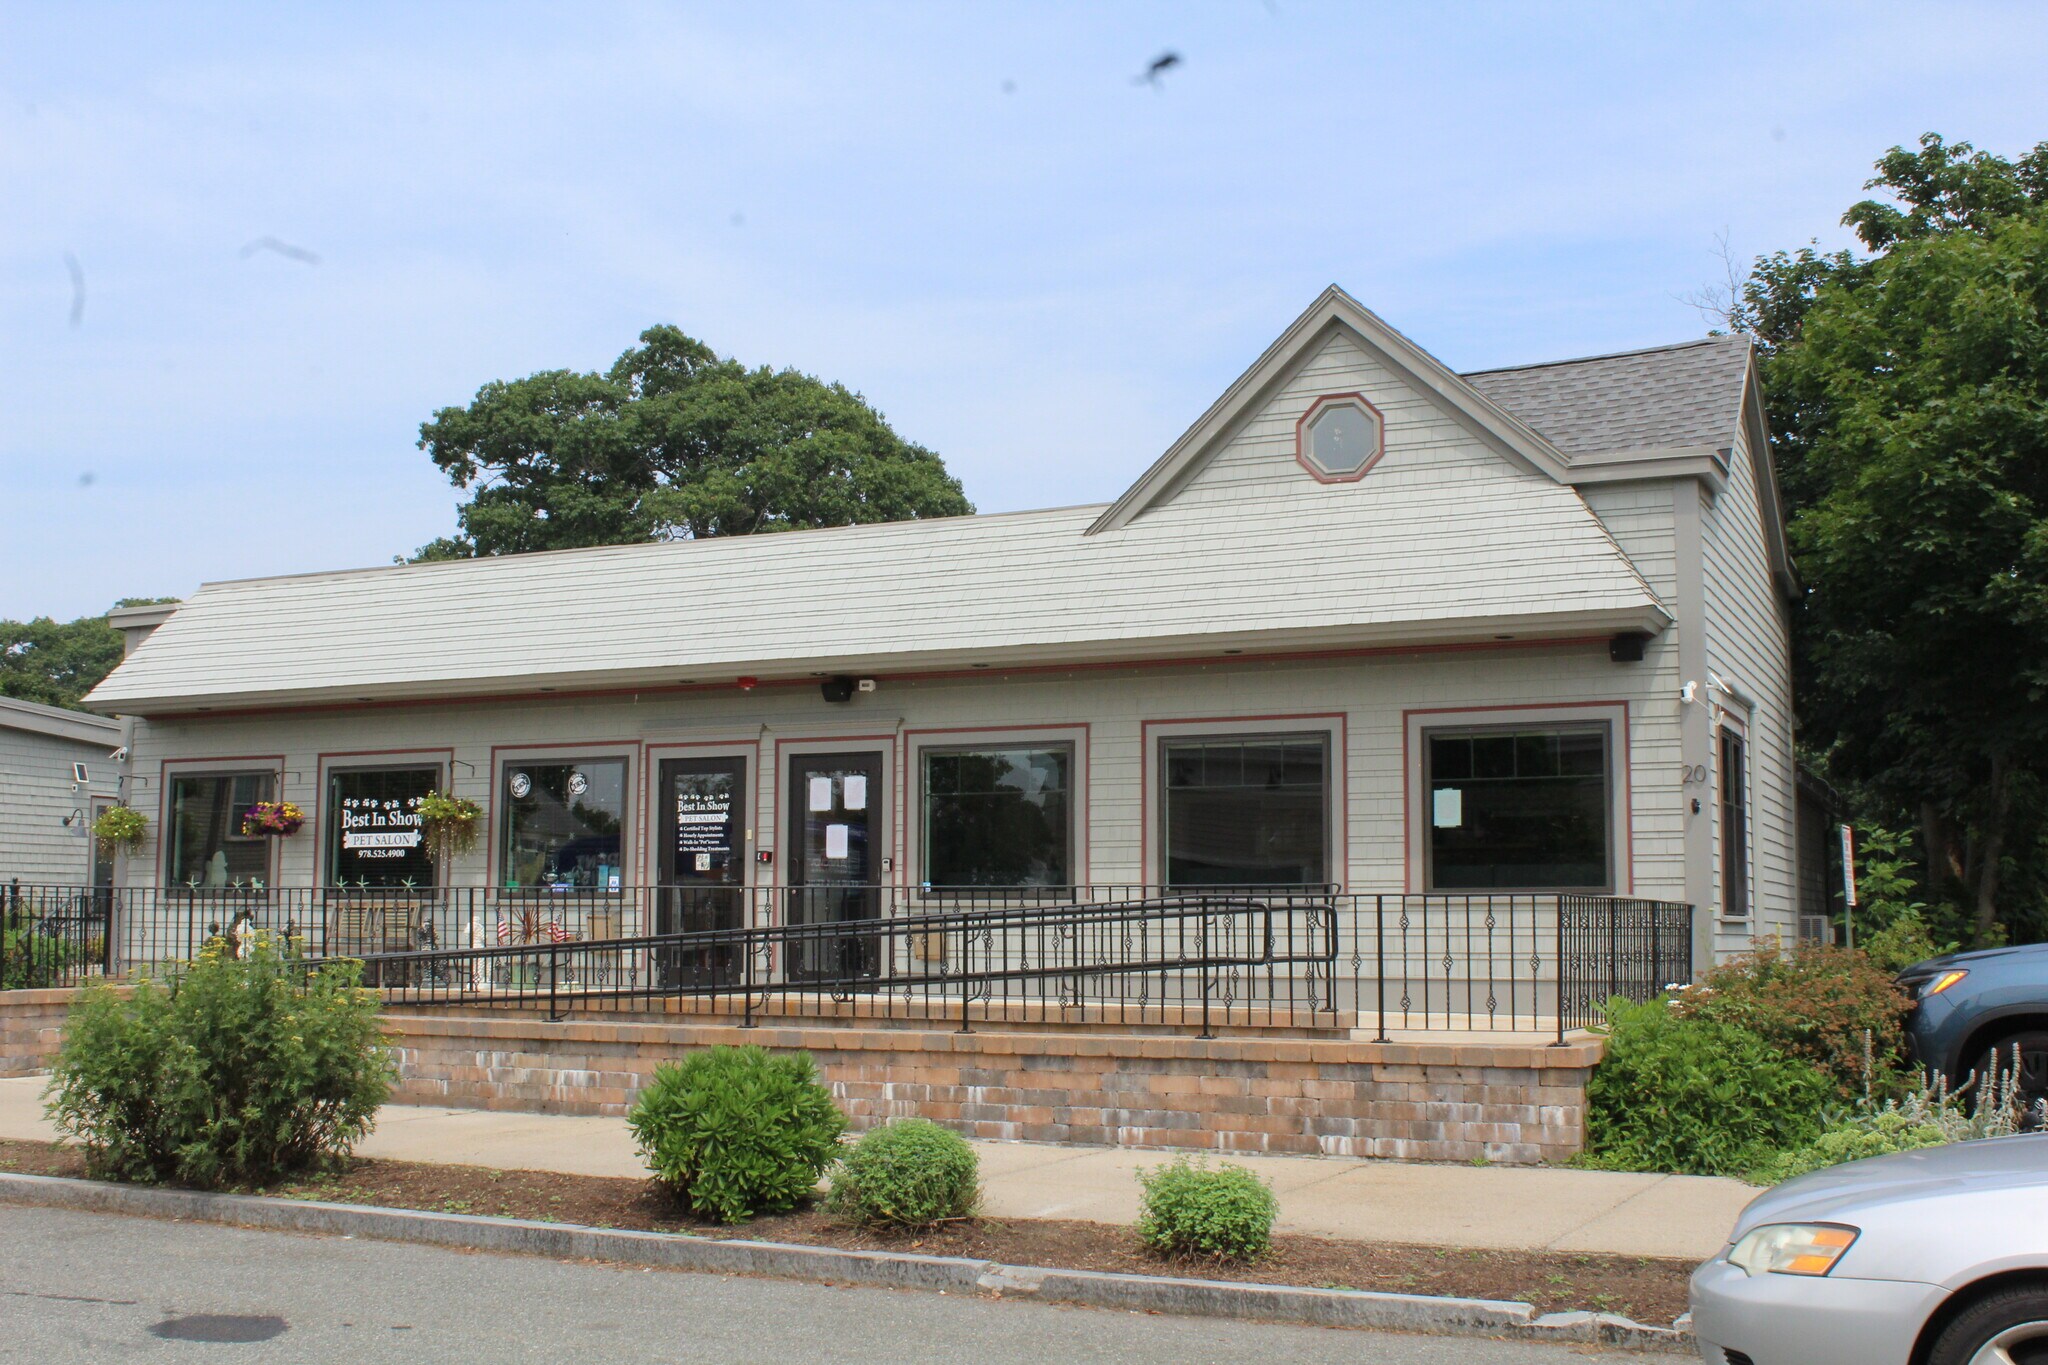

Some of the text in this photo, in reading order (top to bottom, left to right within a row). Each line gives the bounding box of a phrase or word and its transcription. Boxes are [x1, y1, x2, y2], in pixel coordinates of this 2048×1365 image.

[1681, 765, 1706, 783] 20
[677, 800, 730, 812] Best In Show
[341, 809, 422, 829] Best In Show
[353, 834, 410, 846] PET SALON
[358, 849, 405, 859] 978.525.4900
